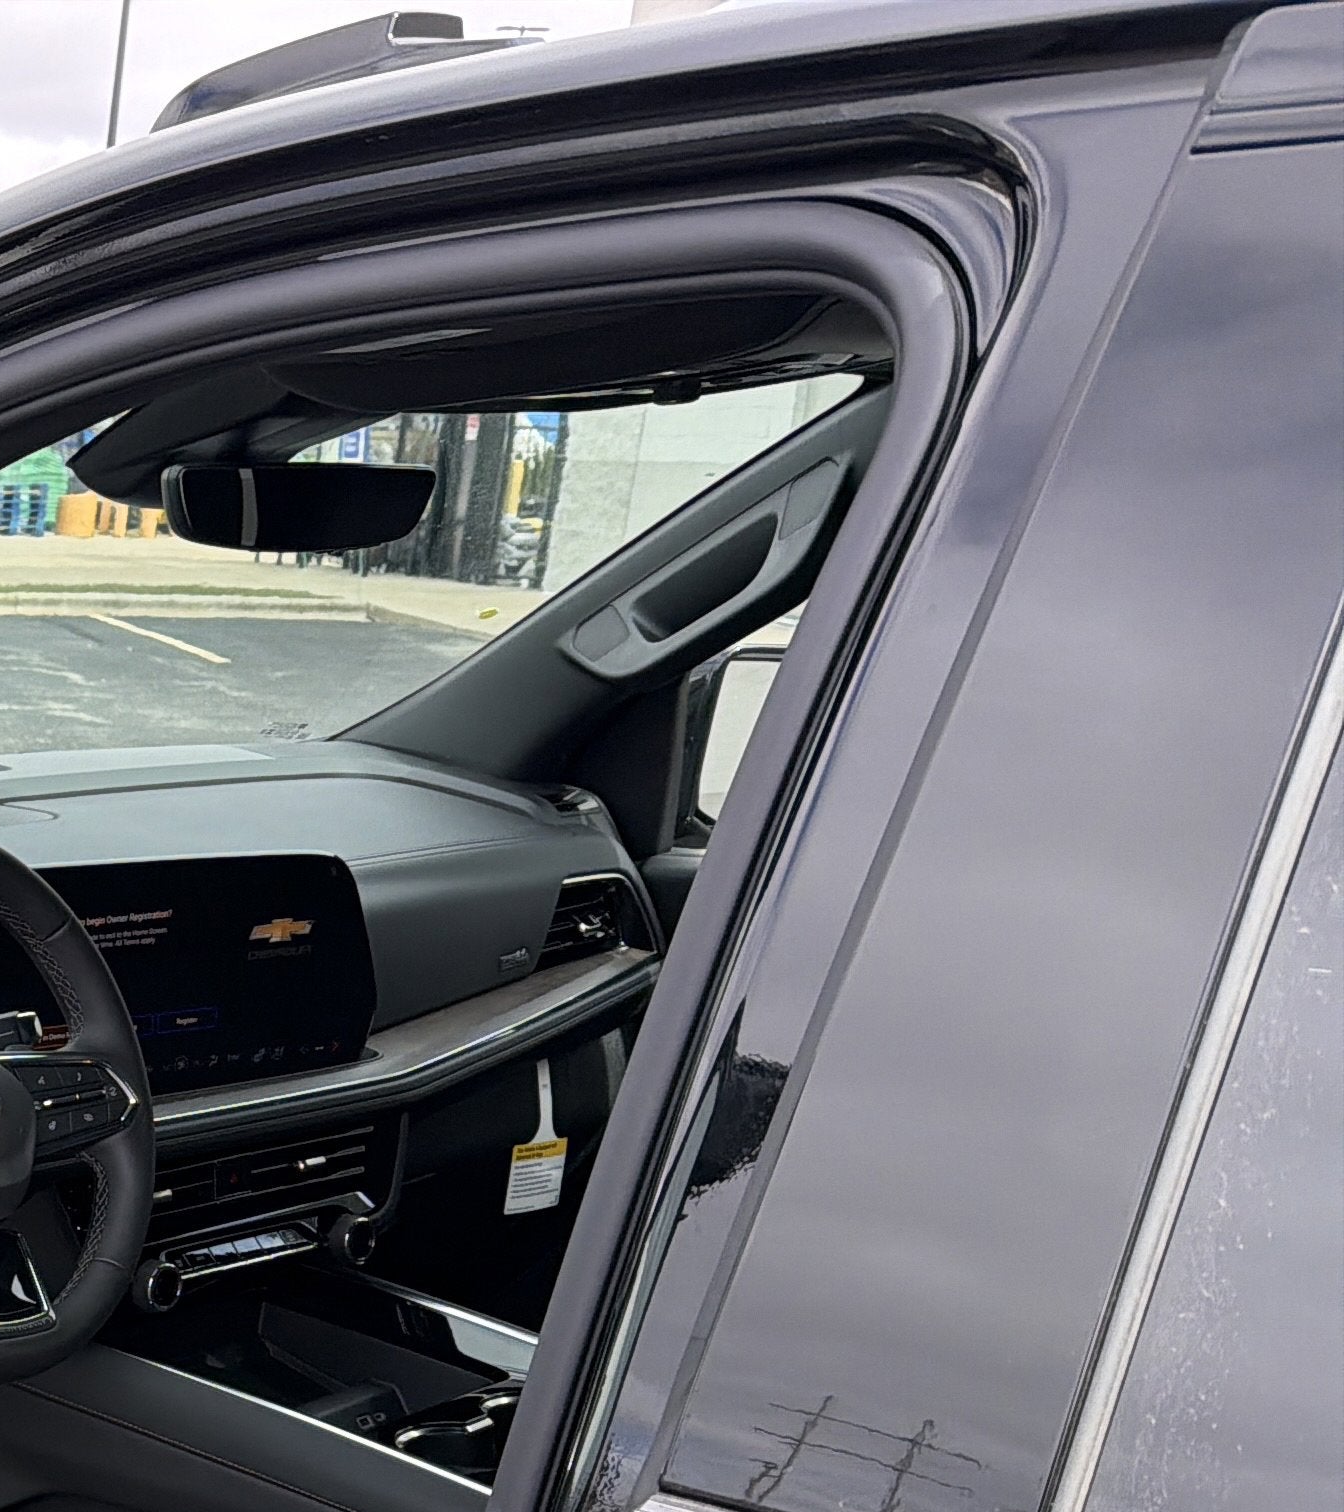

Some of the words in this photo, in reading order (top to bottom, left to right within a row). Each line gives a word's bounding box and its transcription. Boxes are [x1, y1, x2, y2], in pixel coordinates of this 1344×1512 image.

[87, 917, 106, 927] begin
[106, 914, 128, 923] Owner
[129, 909, 173, 922] Registration?
